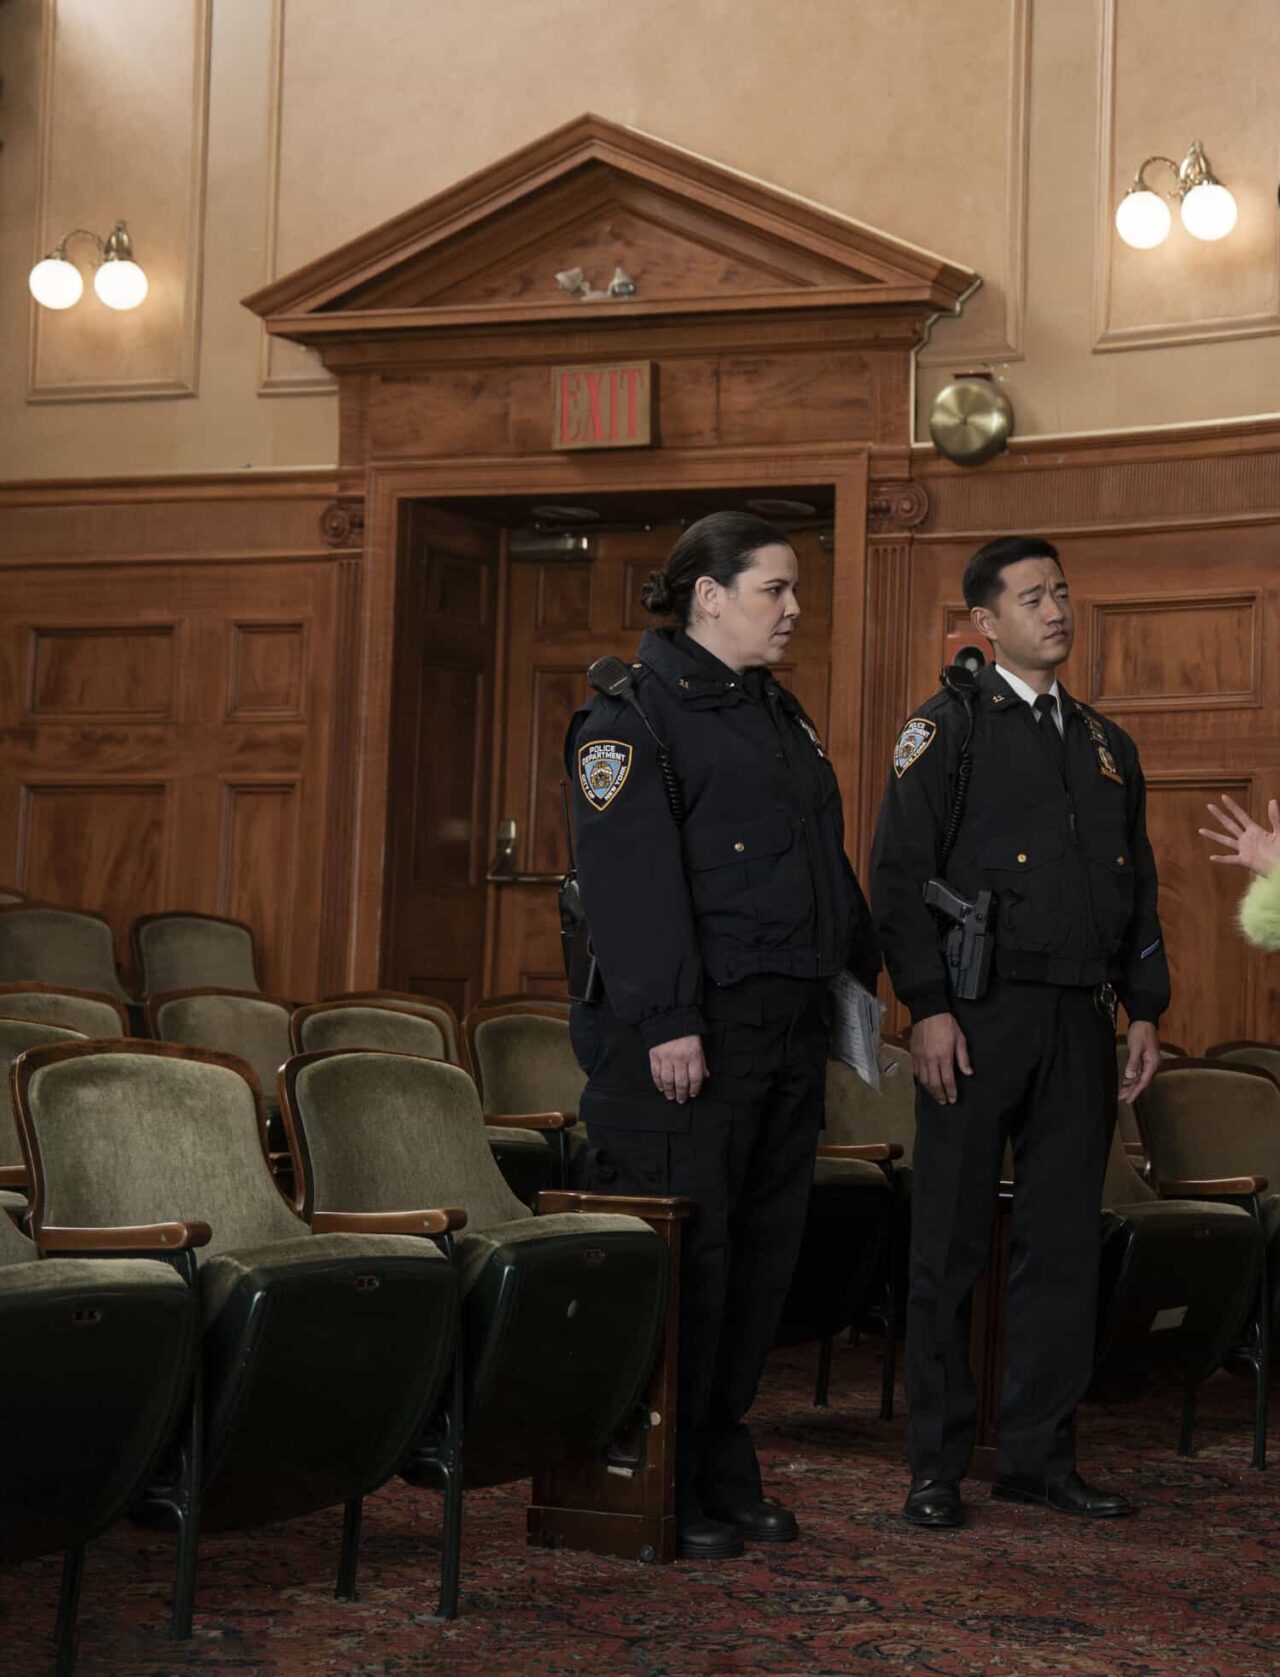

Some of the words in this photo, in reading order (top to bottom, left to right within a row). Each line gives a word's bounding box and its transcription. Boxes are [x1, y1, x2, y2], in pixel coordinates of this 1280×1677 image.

[561, 368, 642, 442] EXIT
[589, 744, 616, 754] POLICE
[582, 752, 626, 766] DEPARTMENT
[614, 766, 627, 785] YORK
